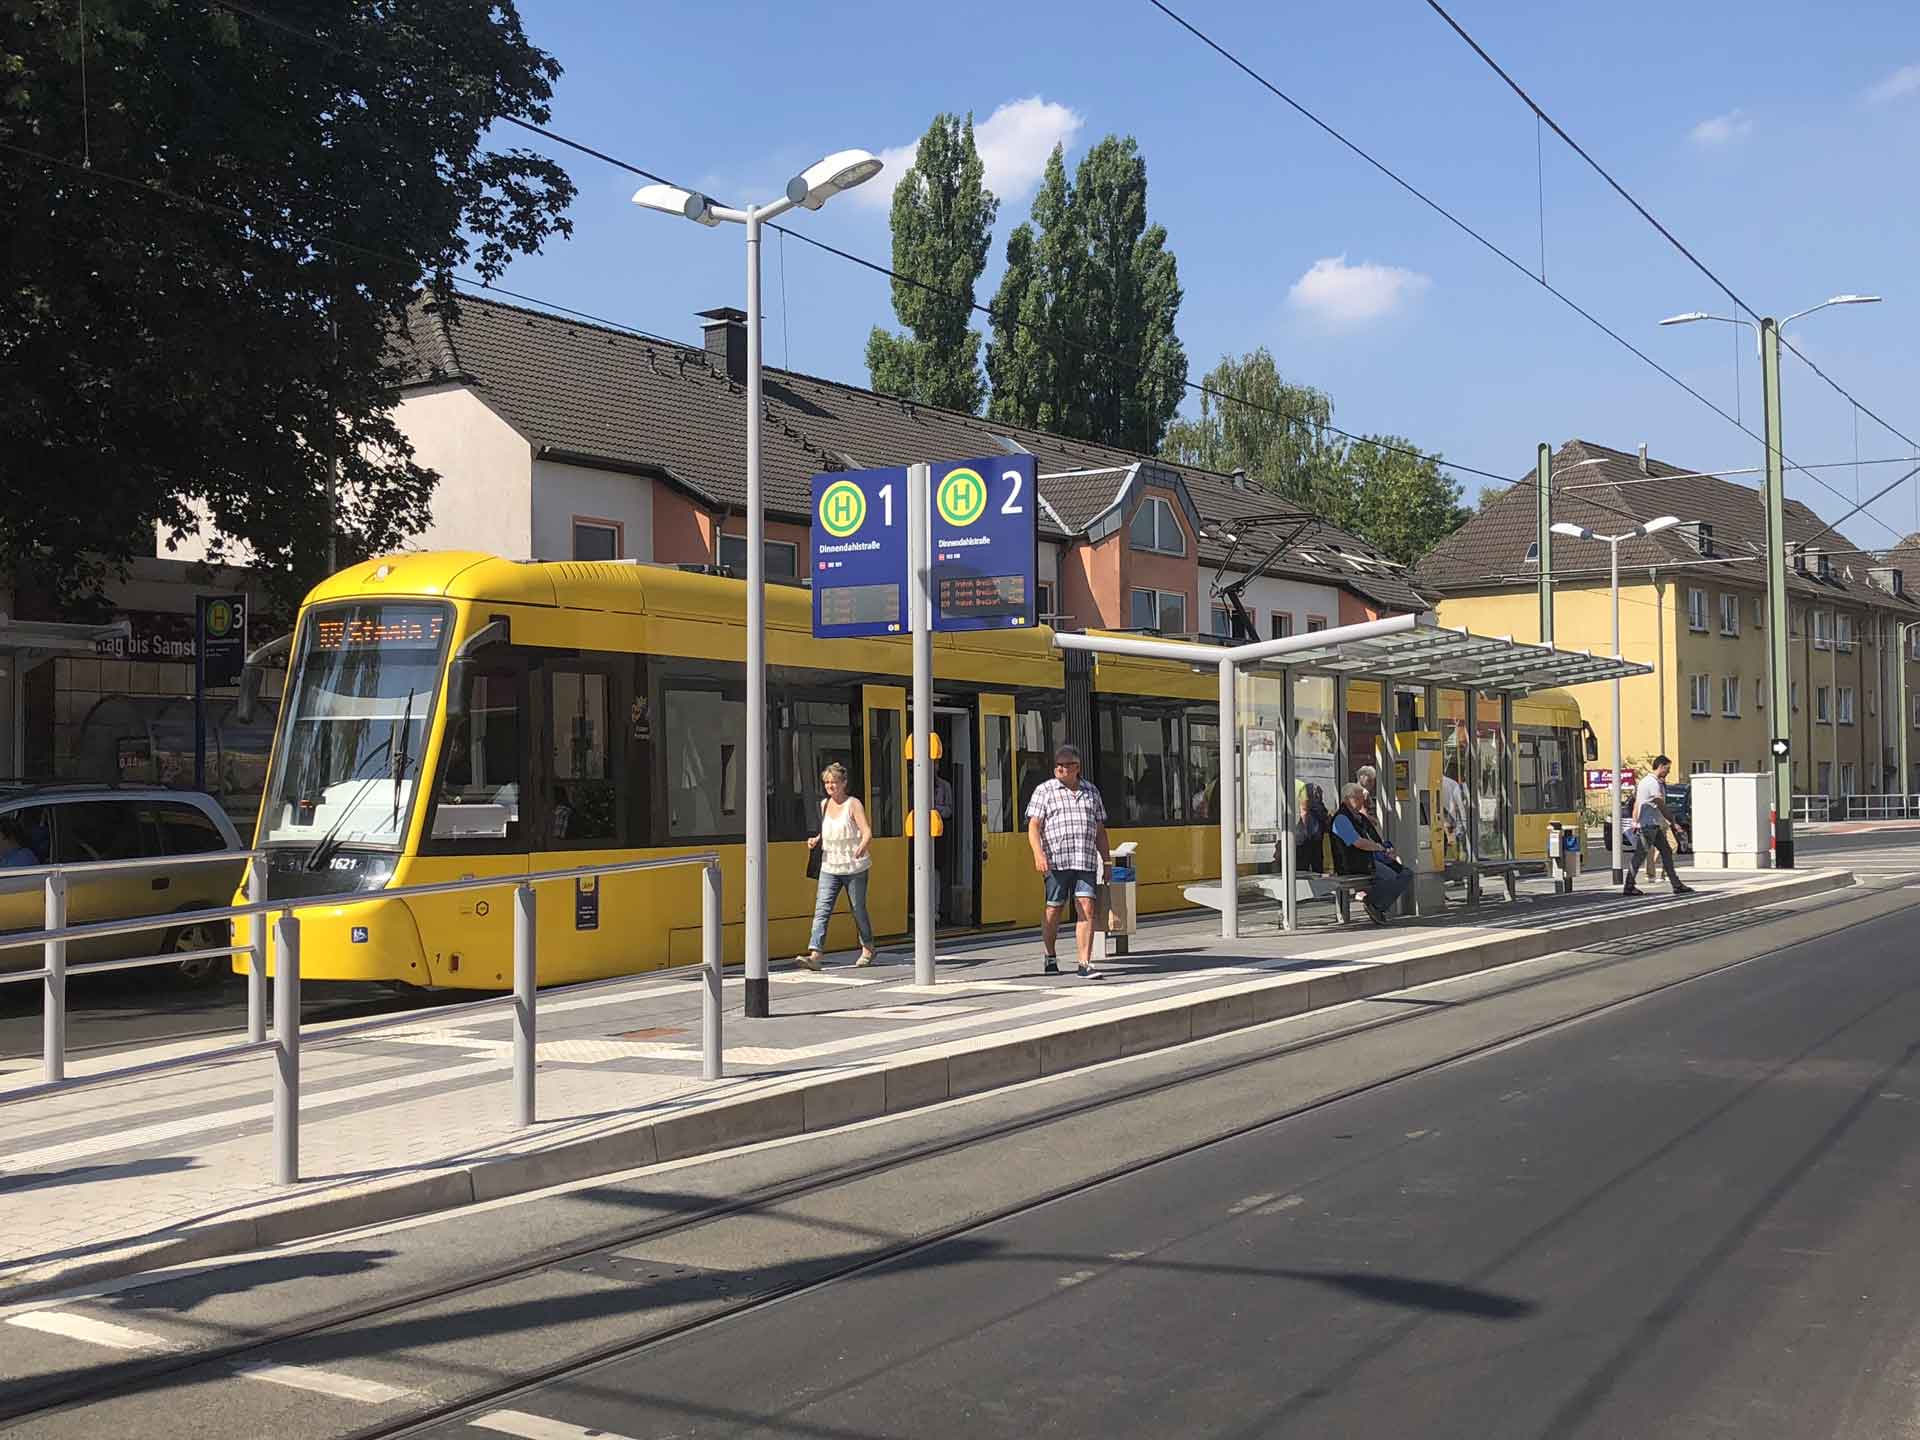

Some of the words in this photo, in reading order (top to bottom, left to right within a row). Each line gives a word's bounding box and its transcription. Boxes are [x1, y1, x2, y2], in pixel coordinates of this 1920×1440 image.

[953, 483, 970, 511] H
[1001, 470, 1023, 515] 2
[834, 495, 851, 522] H
[878, 484, 893, 527] 1
[819, 540, 881, 554] Dinnendahlstraße
[232, 604, 244, 629] 3
[128, 632, 149, 655] bis
[329, 857, 357, 870] 1621
